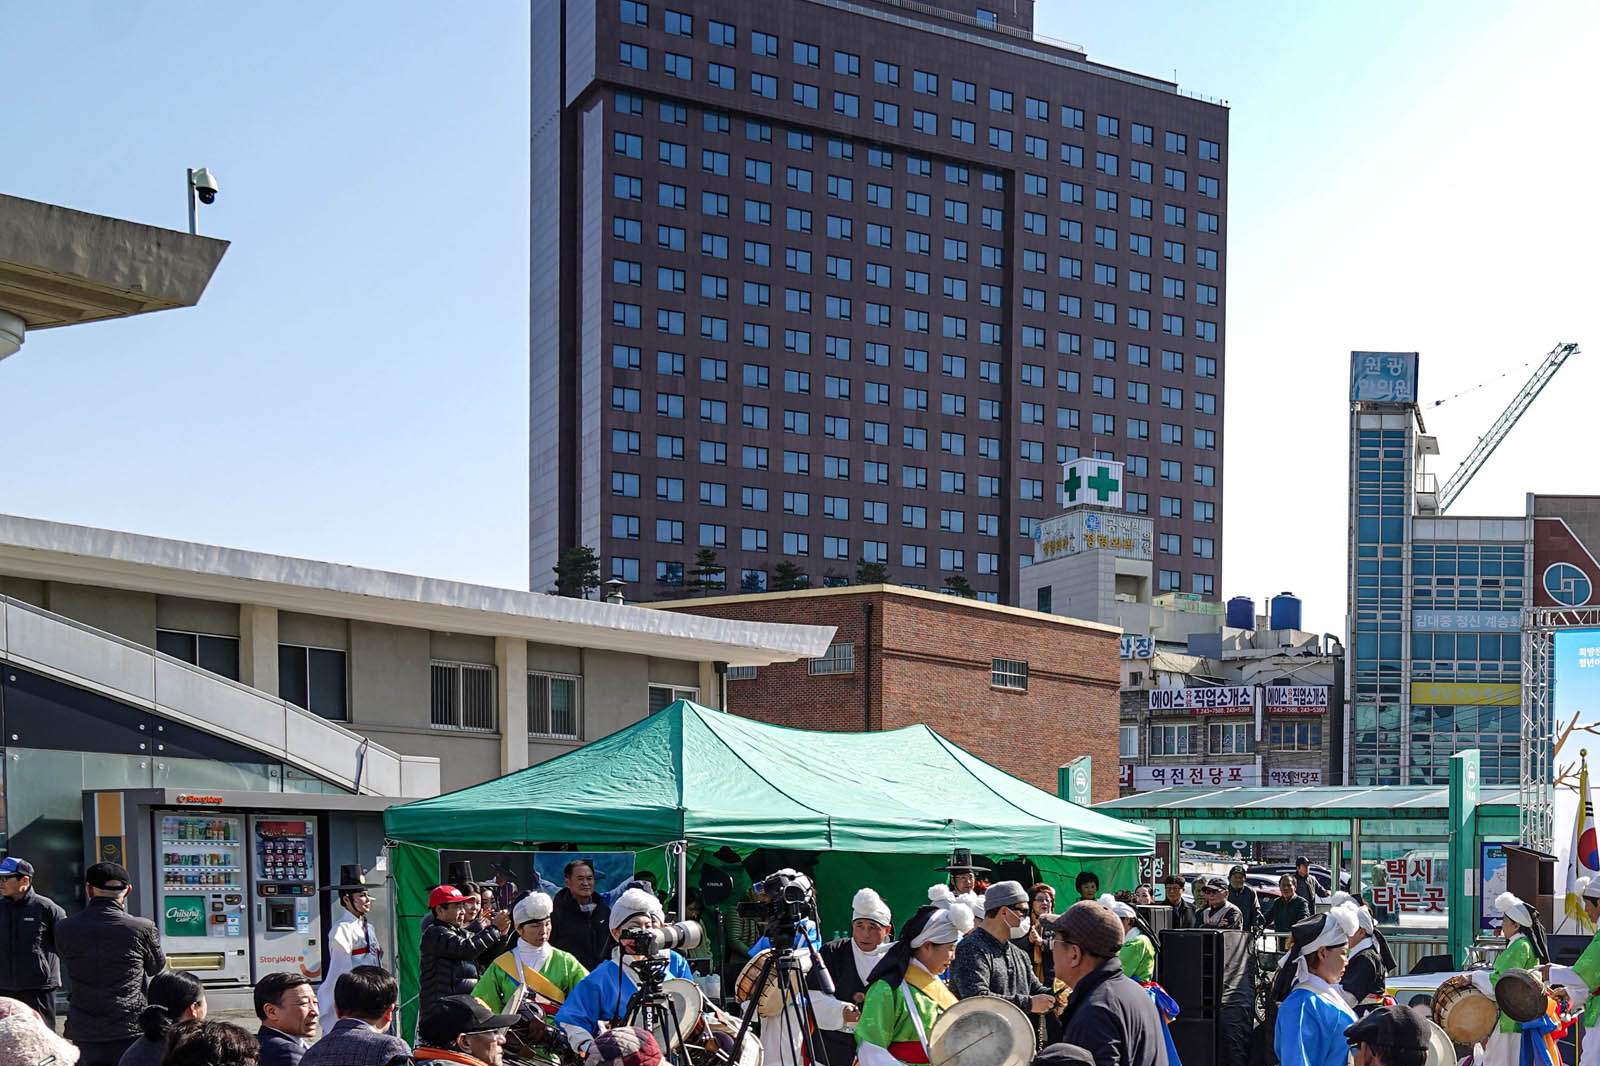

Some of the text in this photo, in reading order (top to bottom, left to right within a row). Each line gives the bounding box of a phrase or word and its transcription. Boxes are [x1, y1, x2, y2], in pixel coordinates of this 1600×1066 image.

[1415, 615, 1453, 628] 김대중
[1152, 690, 1184, 708] 에이스
[1194, 688, 1250, 707] 직업소개소
[1268, 688, 1287, 705] 에이스
[1293, 688, 1326, 705] 직업소개소
[1152, 767, 1243, 786] 역전전당포
[1386, 859, 1432, 885] 택시
[1373, 887, 1446, 913] 타는곳
